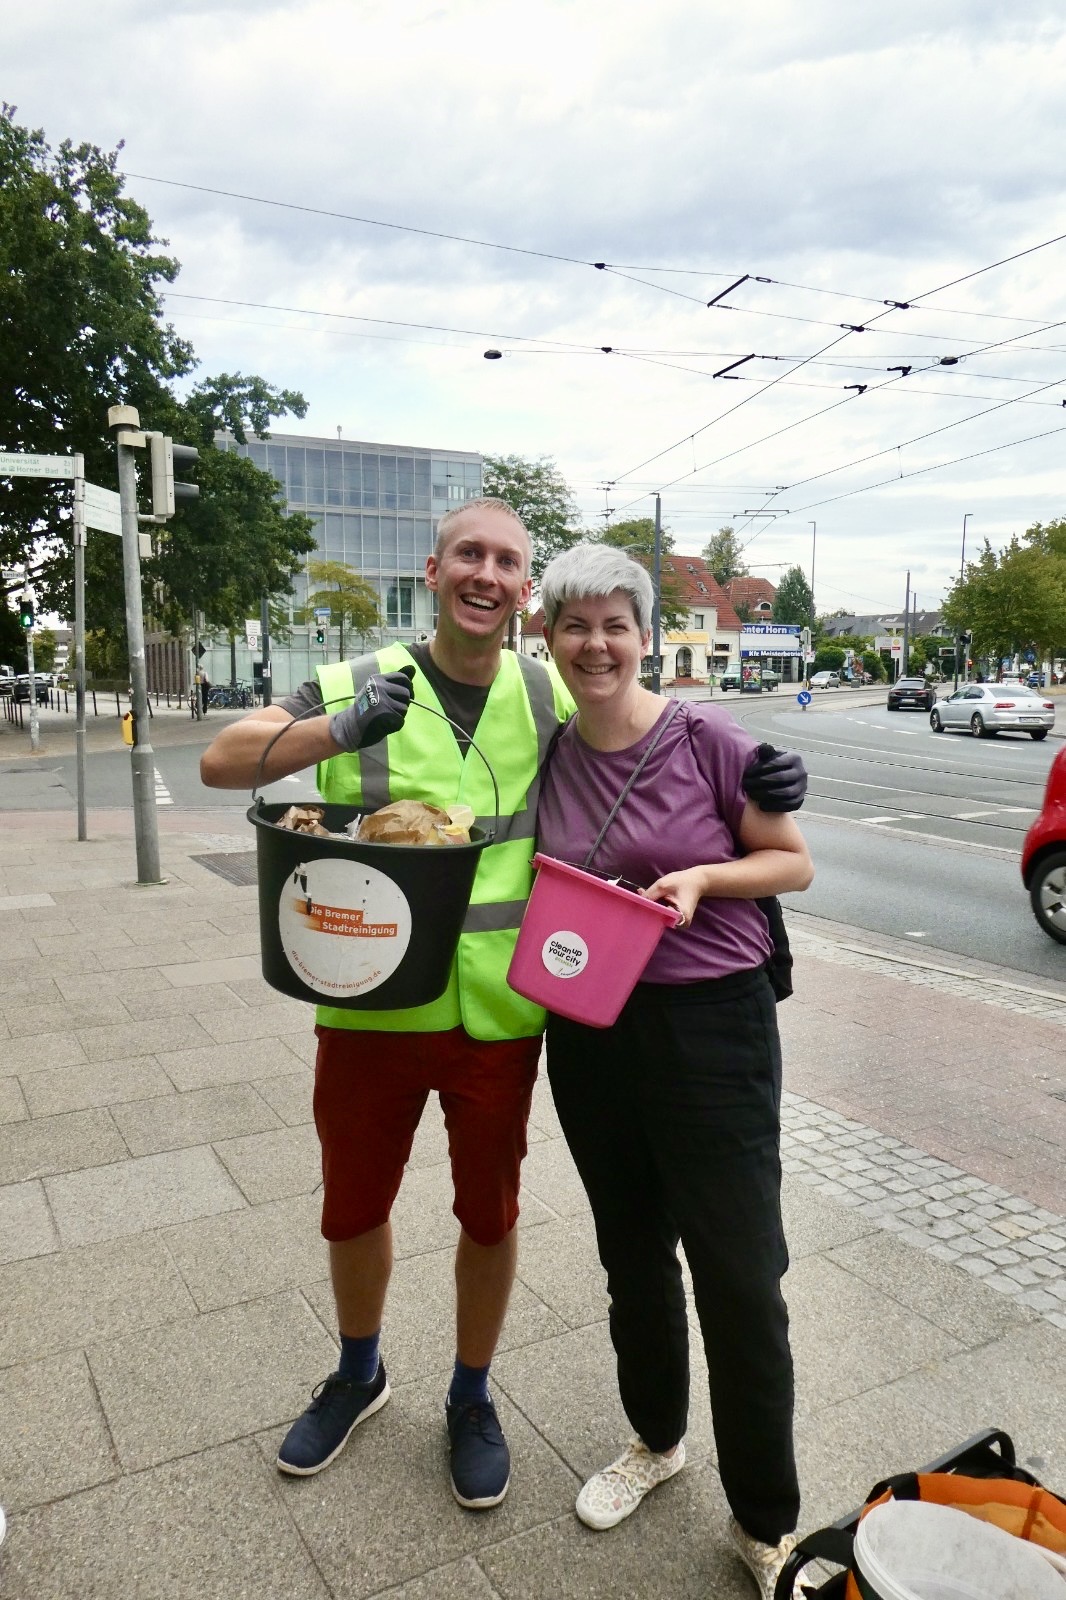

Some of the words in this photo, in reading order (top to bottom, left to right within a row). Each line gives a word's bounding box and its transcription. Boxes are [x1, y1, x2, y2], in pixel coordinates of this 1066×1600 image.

[1, 456, 40, 465] Universität
[17, 466, 42, 474] Horner
[45, 467, 59, 475] Bad
[765, 626, 788, 634] Horn
[325, 909, 360, 921] Bremer
[322, 921, 395, 935] Stadtreinigung
[549, 947, 565, 957] your
[566, 956, 580, 966] city
[291, 950, 382, 989] die-bremer-stadtreinigung.de
